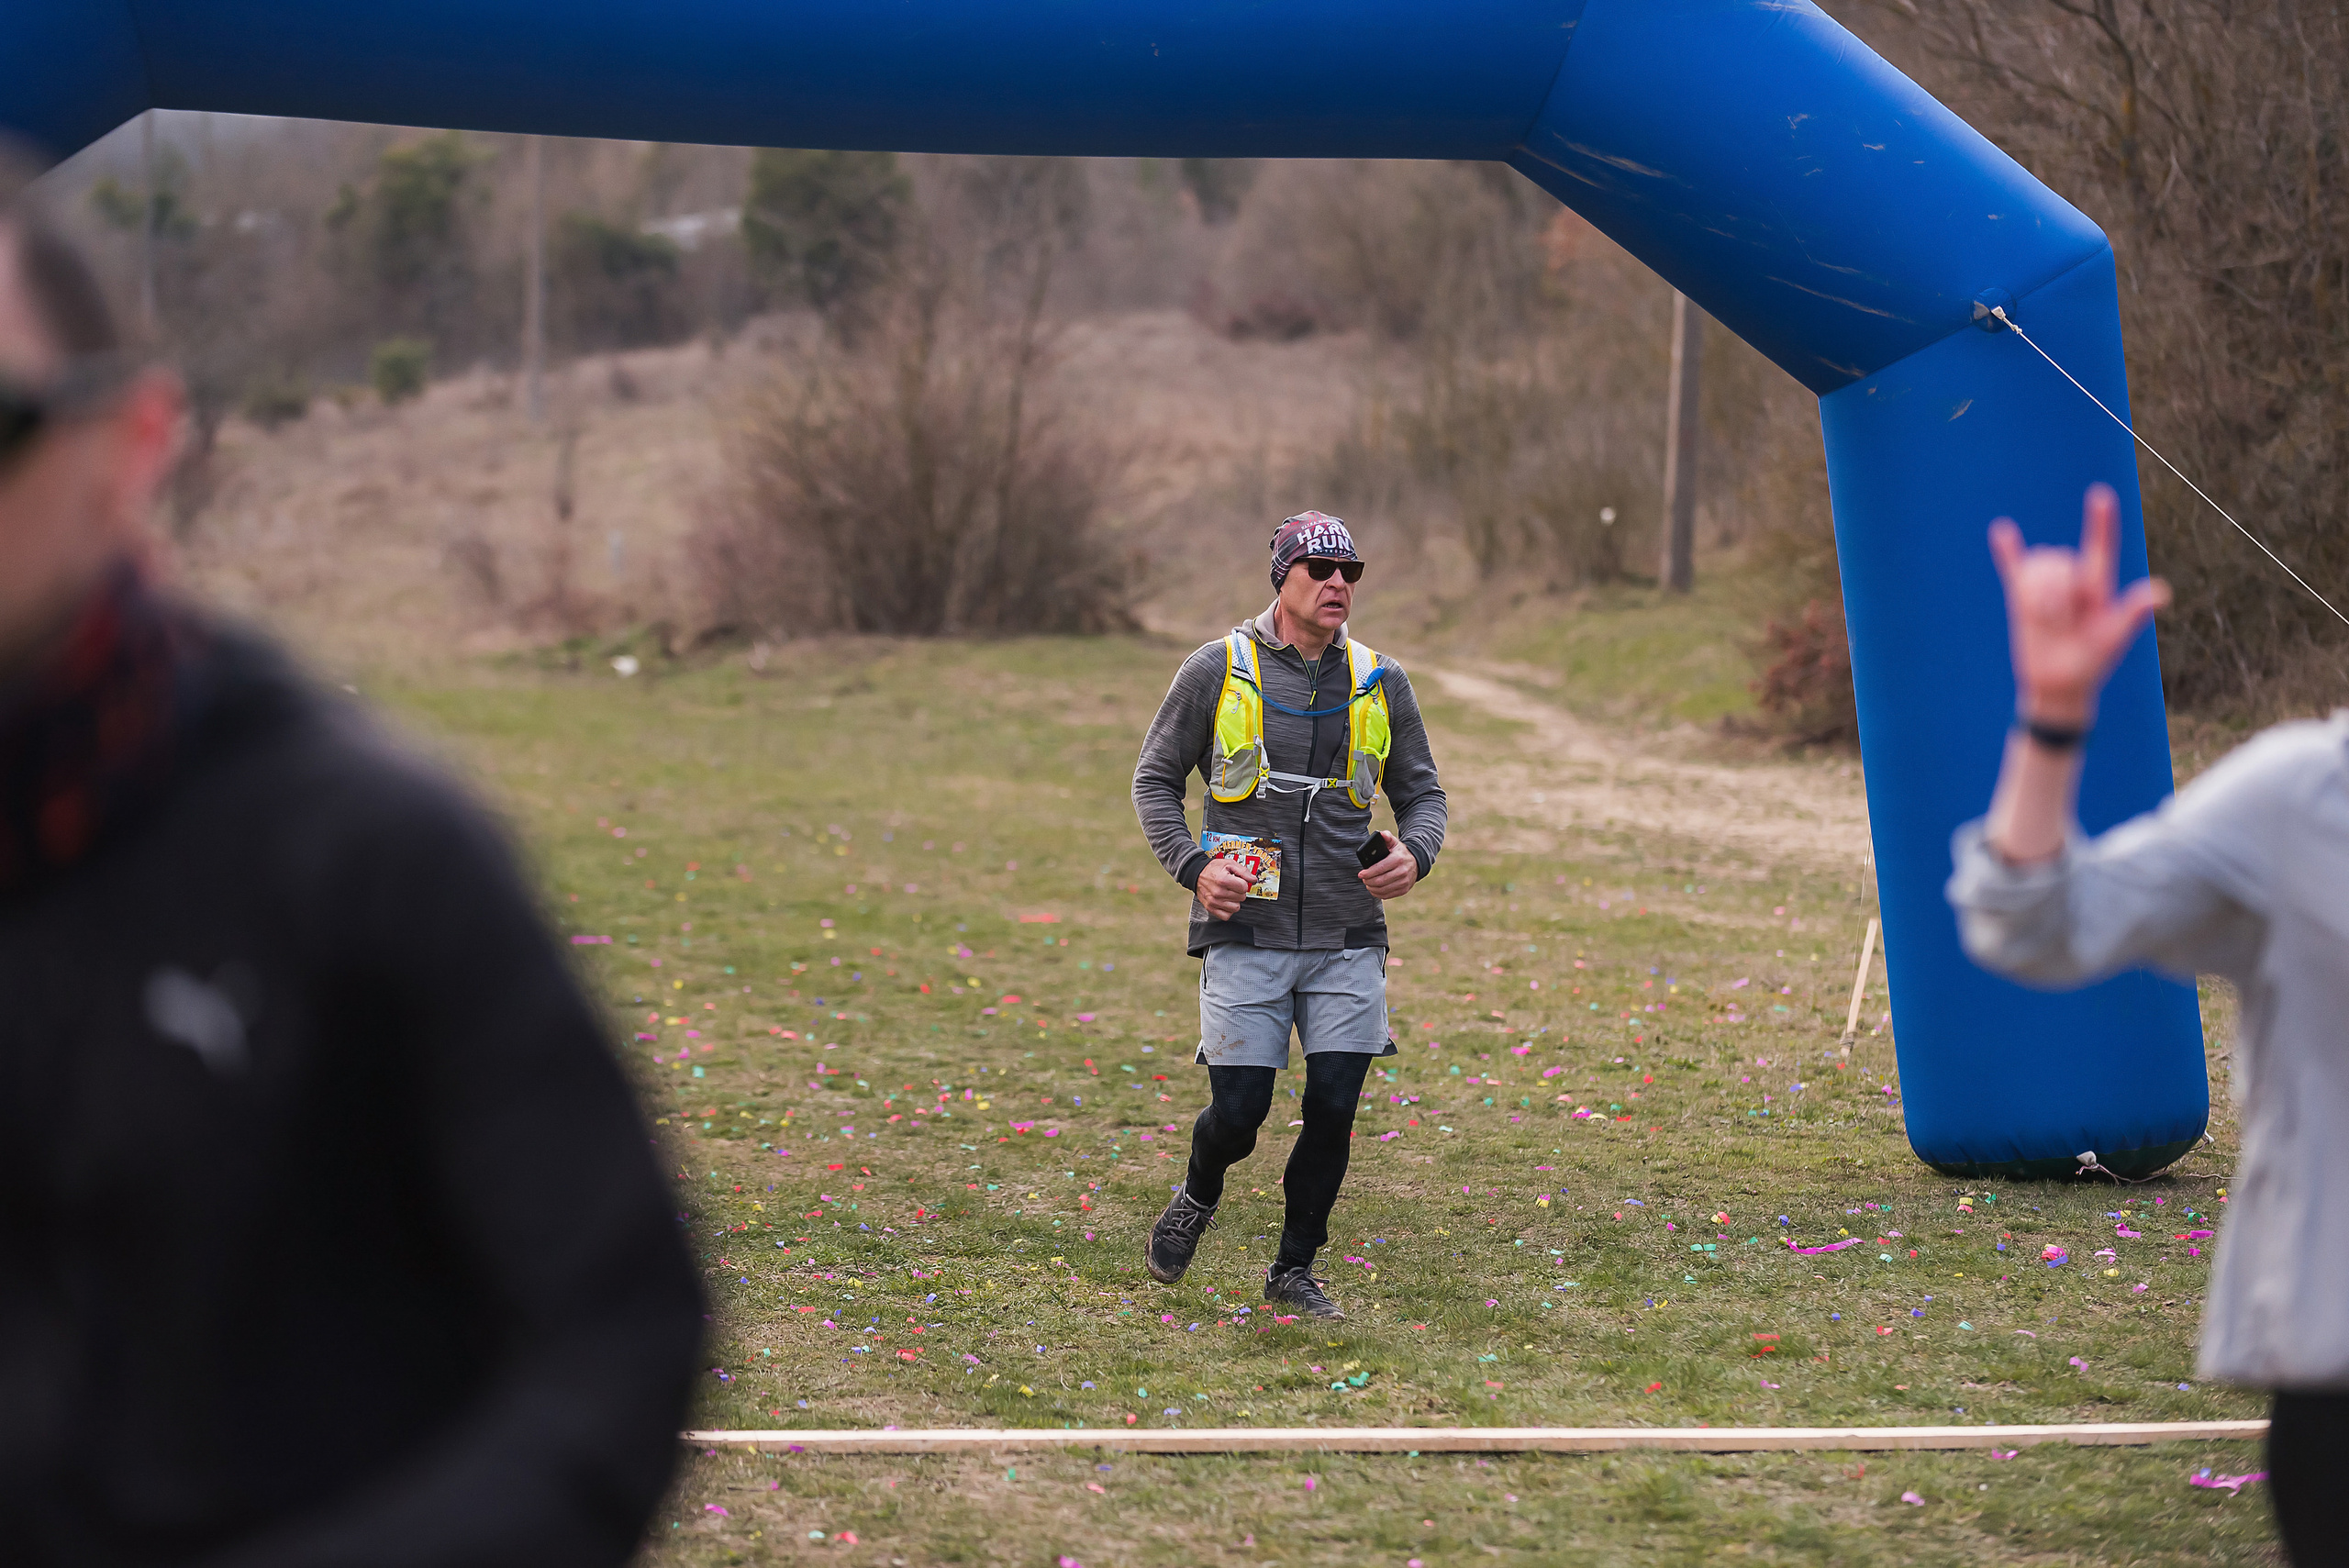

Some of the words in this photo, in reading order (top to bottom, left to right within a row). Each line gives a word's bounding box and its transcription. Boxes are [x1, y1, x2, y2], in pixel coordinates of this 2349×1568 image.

[1297, 523, 1351, 545] HARD
[1307, 535, 1351, 554] RUN
[1206, 832, 1213, 842] 12
[1252, 845, 1274, 866] TRAIL
